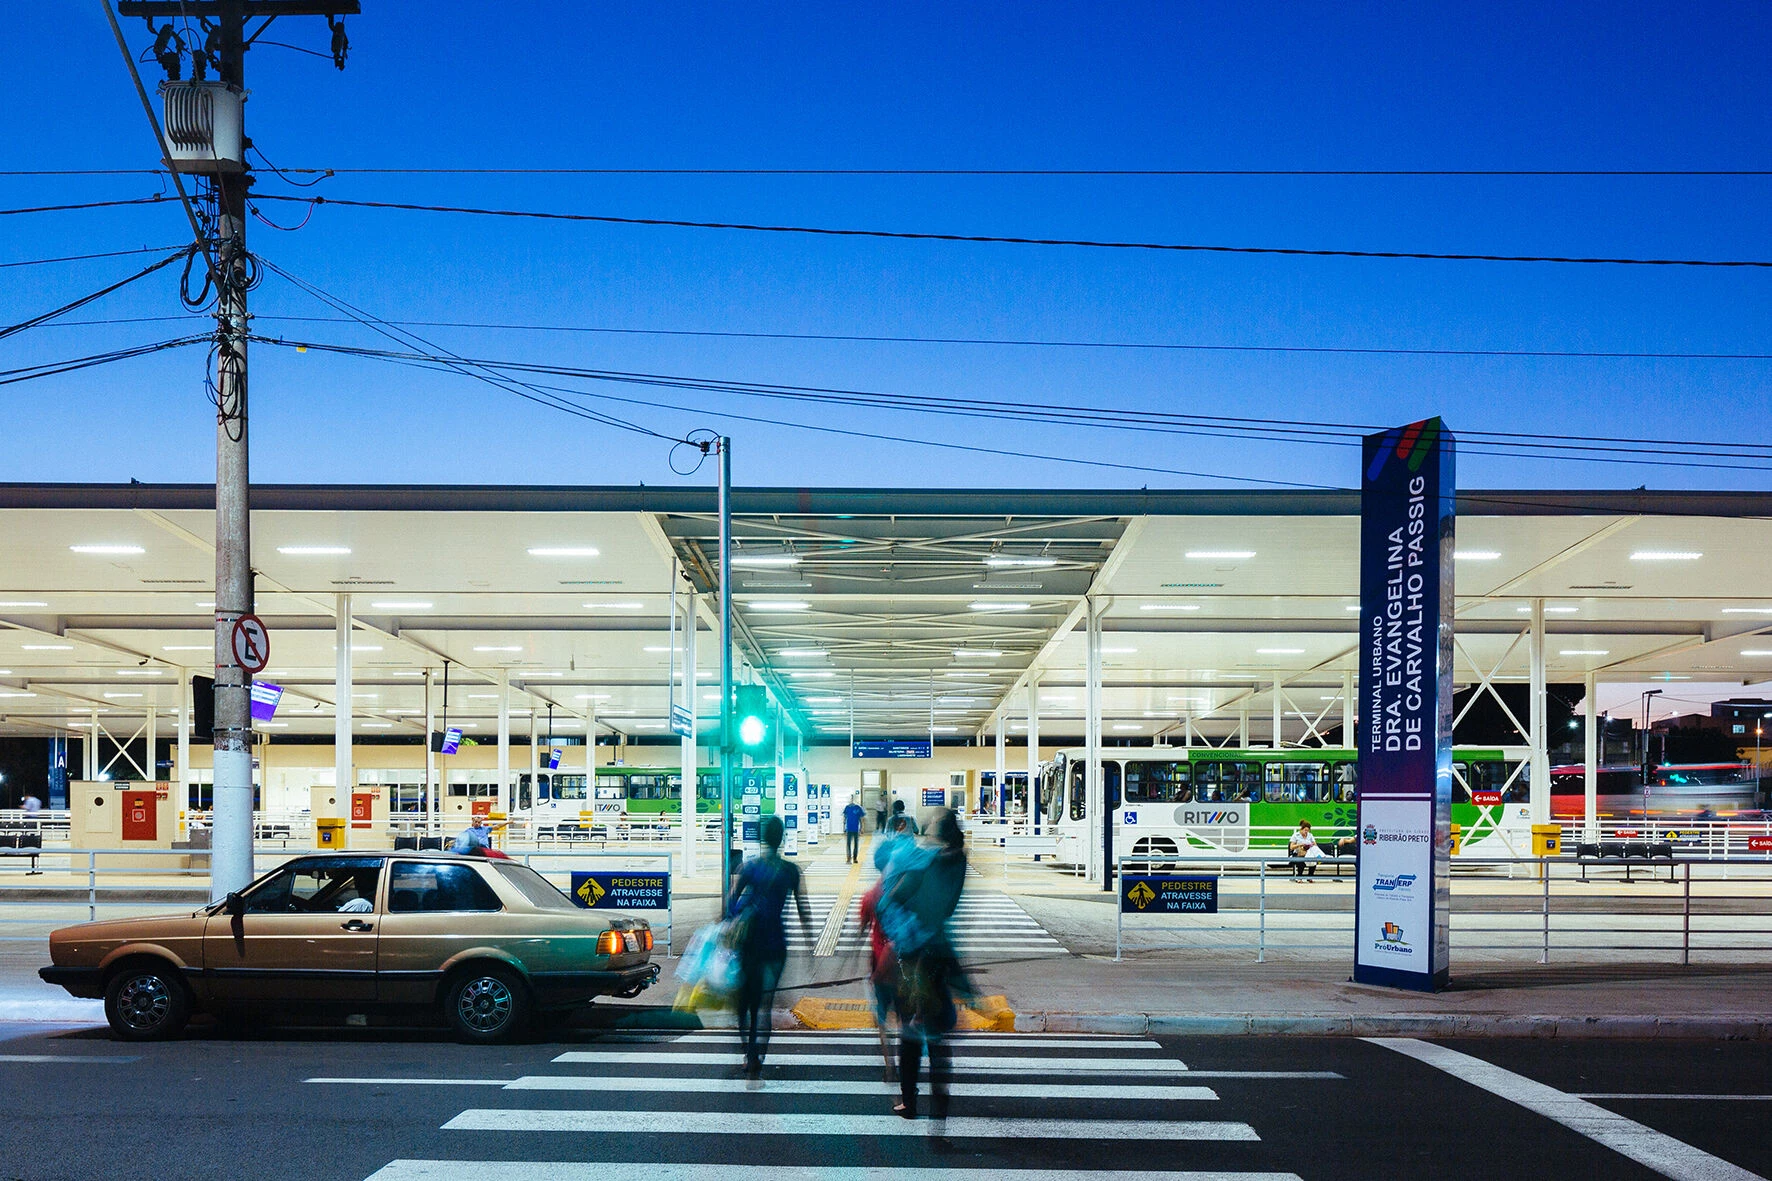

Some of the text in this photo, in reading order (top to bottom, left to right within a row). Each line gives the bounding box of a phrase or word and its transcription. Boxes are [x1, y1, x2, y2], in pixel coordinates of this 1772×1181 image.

[1405, 475, 1425, 751] DE CARVALHO PASSIG
[1385, 526, 1404, 752] DRA. EVANGELINA
[245, 627, 258, 662] E
[1371, 615, 1383, 753] TERMINAL URBANO
[57, 755, 65, 768] A
[748, 779, 756, 787] D
[1378, 833, 1429, 843] RIBEIRÃO PRETO
[611, 878, 663, 887] PEDESTRE
[1161, 881, 1213, 890] PEDESTRE
[610, 888, 663, 897] ATRAVESSE
[1160, 891, 1213, 900] ATRAVESSE
[616, 898, 657, 907] NA FAIXA
[1166, 901, 1207, 910] NA FAIXA
